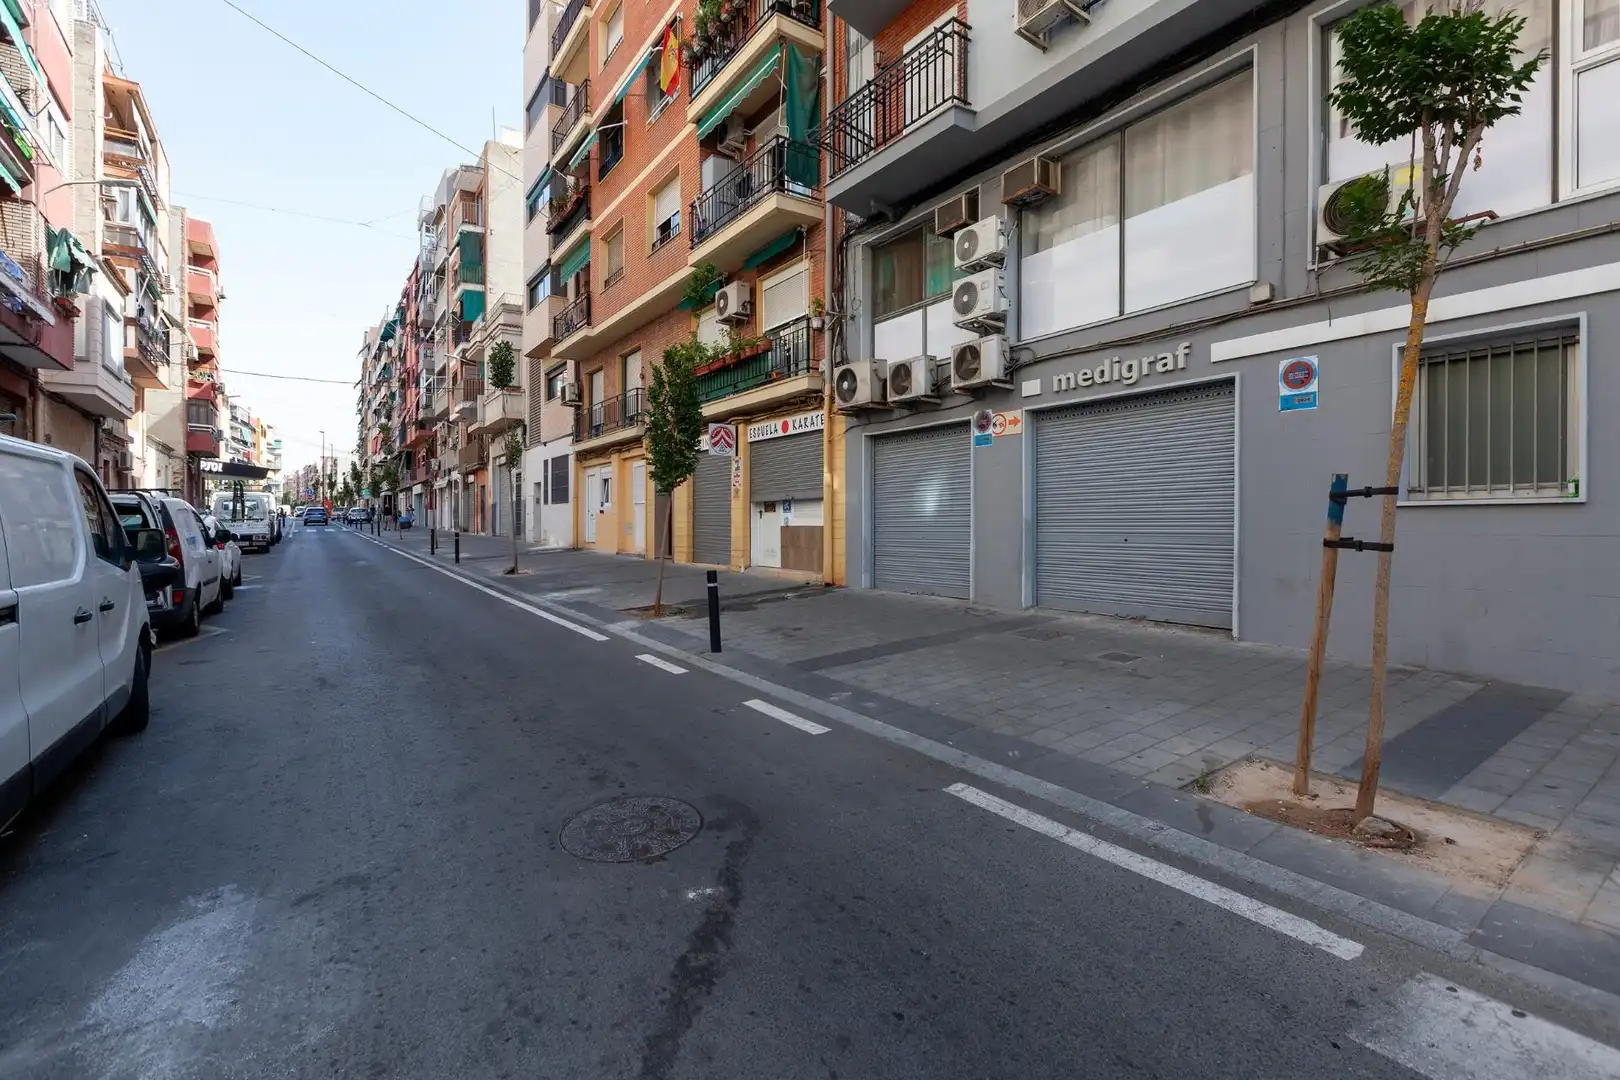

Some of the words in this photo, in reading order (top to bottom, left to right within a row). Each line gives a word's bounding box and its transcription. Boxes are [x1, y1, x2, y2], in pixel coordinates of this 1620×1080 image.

[1052, 341, 1191, 393] medigraf
[749, 423, 778, 439] ESCUELA
[792, 413, 824, 431] KARATE
